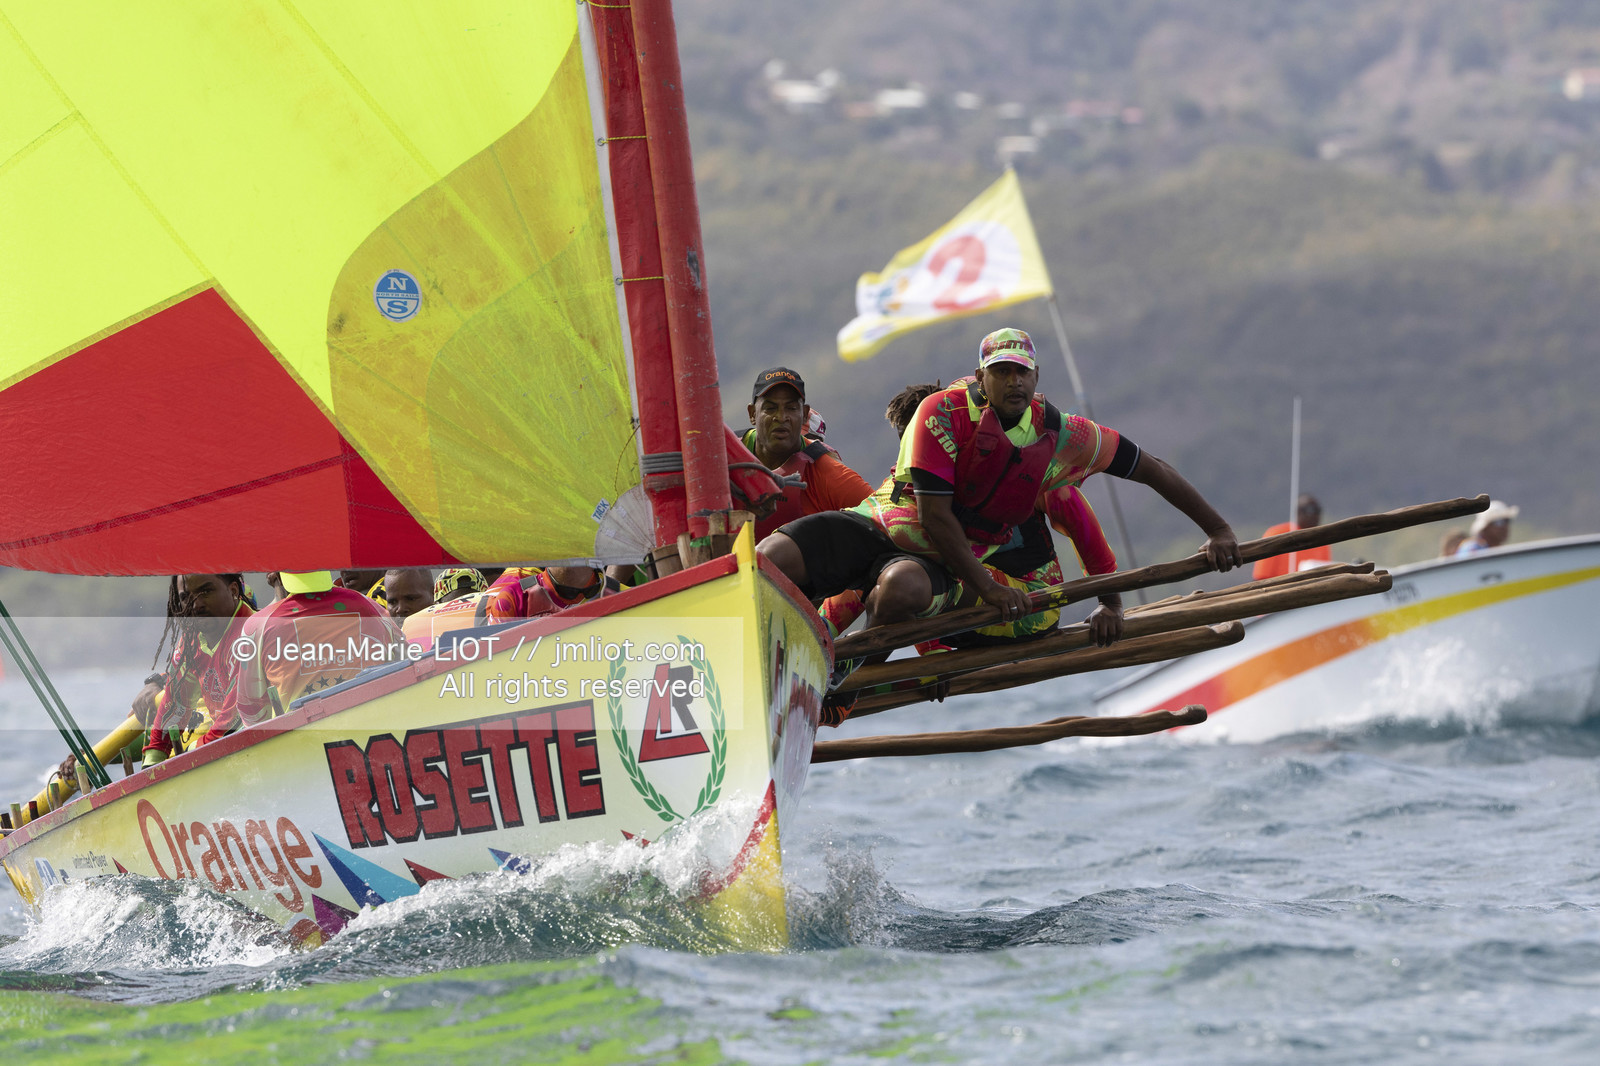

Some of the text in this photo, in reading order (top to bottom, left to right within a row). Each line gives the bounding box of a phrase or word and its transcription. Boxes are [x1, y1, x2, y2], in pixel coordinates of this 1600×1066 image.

[927, 234, 1003, 312] 2
[388, 277, 408, 290] N
[387, 301, 409, 313] S
[765, 370, 796, 381] Orange
[924, 415, 959, 463] YOLES
[593, 500, 609, 519] TACK
[434, 602, 478, 615] ROSETTE
[323, 699, 606, 849] ROSETTE
[136, 798, 323, 913] Orange
